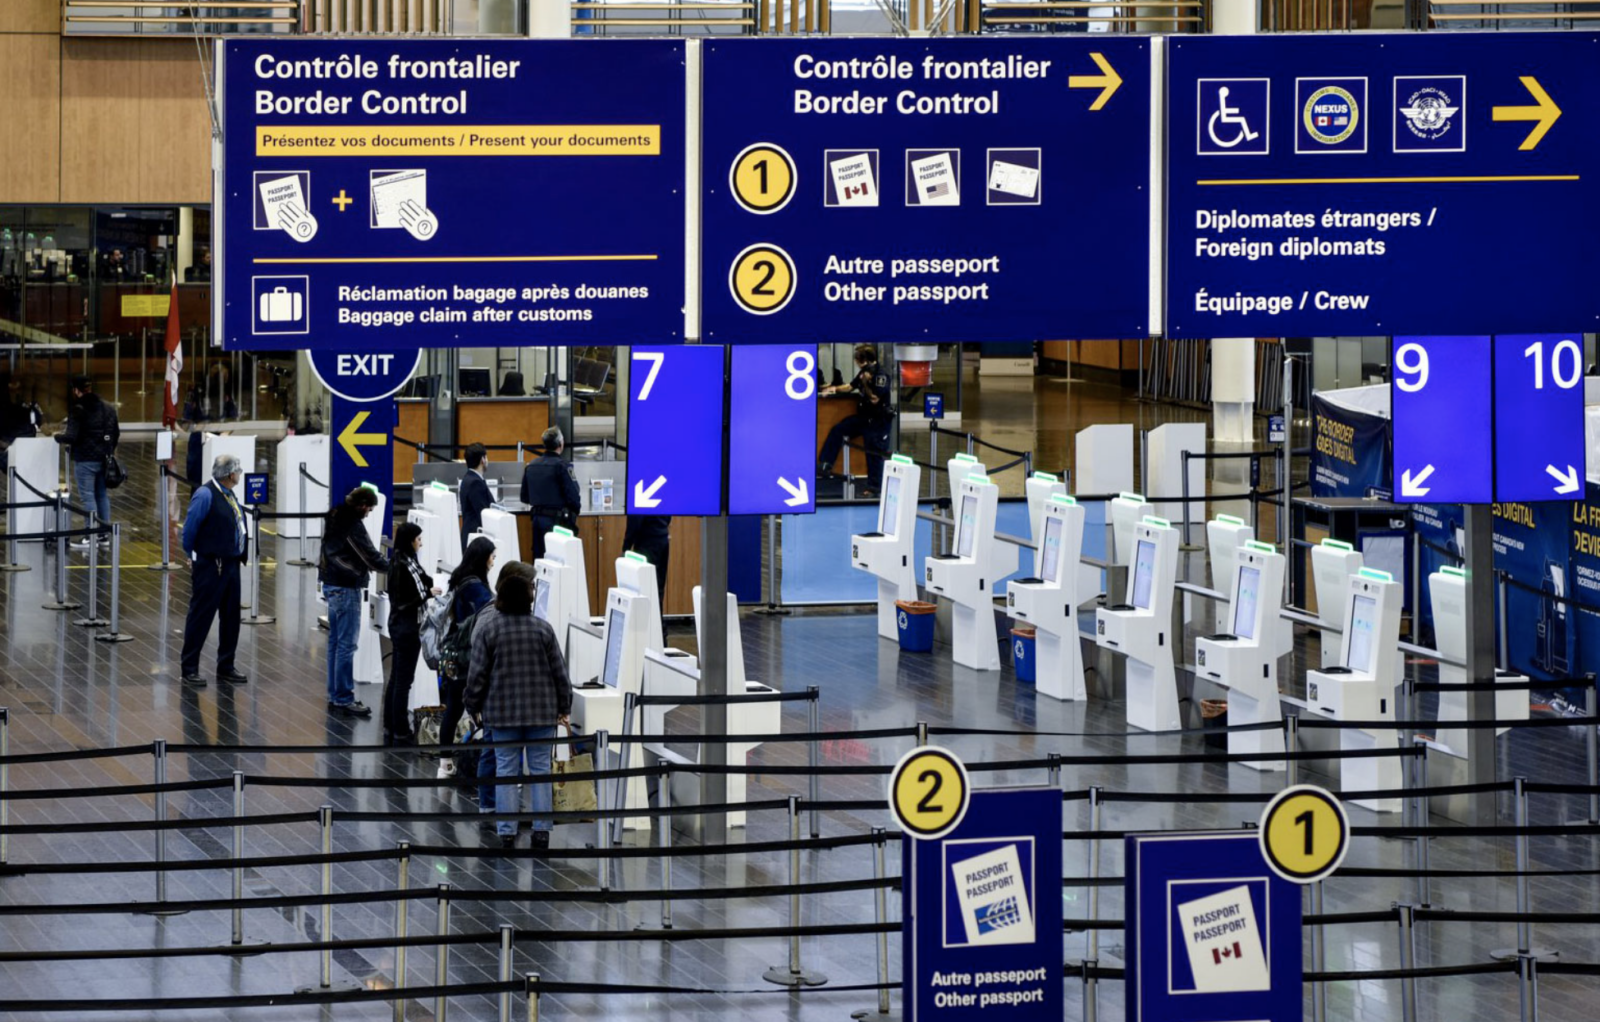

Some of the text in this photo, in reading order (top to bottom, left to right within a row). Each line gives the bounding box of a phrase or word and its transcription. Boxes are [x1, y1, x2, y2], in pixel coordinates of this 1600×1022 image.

[255, 53, 520, 79] Contrôle frontalier
[794, 54, 1051, 79] Contrôle frontalier
[256, 90, 466, 114] Border Control
[795, 90, 998, 114] Border Control
[1315, 105, 1347, 113] NEXUS
[263, 134, 650, 148] Présentez vos documents / Present your documents
[753, 160, 767, 194] 1
[268, 184, 293, 195] PASSPORT
[268, 192, 297, 203] PASSEPORT
[1196, 208, 1436, 233] Diplomates étrangers /
[1196, 237, 1385, 260] Foreign diplomats
[752, 261, 775, 295] 2
[824, 255, 999, 277] Autre passeport
[339, 284, 648, 303] Réclamation bagage après douanes
[825, 282, 988, 304] Other passport
[1196, 288, 1369, 315] Équipage / Crew
[339, 307, 592, 326] Baggage claim after customs
[338, 355, 394, 375] EXIT
[632, 352, 664, 400] 7
[785, 351, 815, 400] 8
[1395, 343, 1429, 392] 9
[1525, 340, 1582, 389] 10
[1503, 503, 1535, 528] DIGITAL
[917, 770, 942, 813] 2
[1295, 811, 1313, 855] 1
[966, 862, 1008, 884] PASSPORT
[967, 875, 1013, 899] PASSEPORT
[1193, 904, 1240, 927] PASSPORT
[1194, 918, 1246, 943] PASSEPORT
[931, 967, 1046, 987] Autre passeport
[935, 989, 1043, 1007] Other passport
